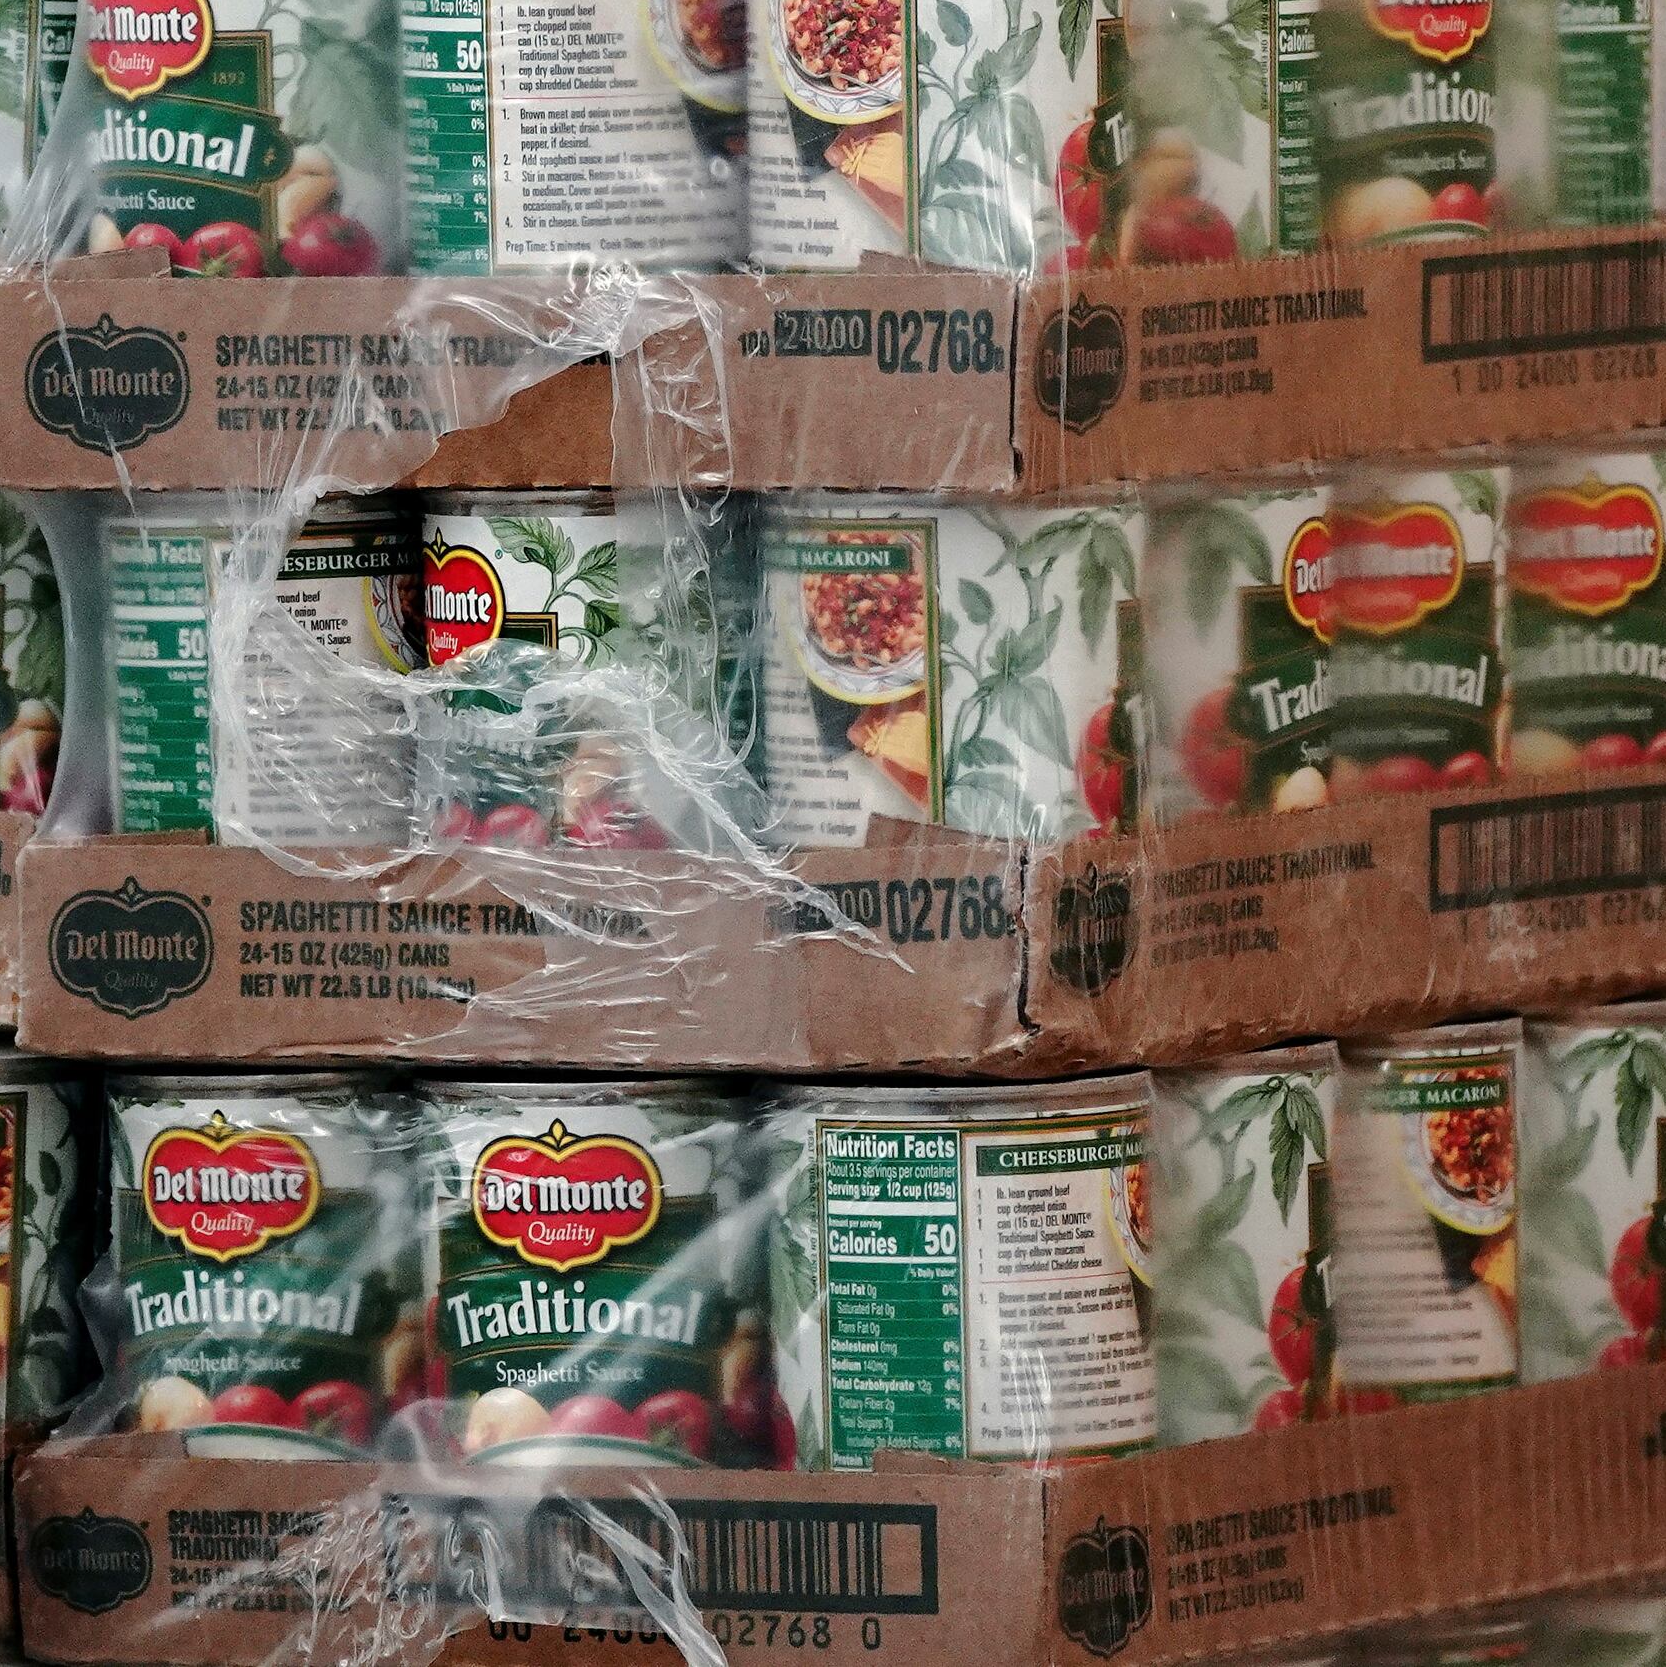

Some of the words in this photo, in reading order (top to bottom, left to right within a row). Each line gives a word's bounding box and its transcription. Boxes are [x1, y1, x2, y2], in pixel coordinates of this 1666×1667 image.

[112, 5, 199, 44] Monte
[528, 5, 546, 17] lean
[547, 5, 576, 21] ground
[576, 4, 596, 17] beef
[1419, 11, 1469, 38] Quality
[533, 20, 567, 34] chopped
[107, 49, 155, 74] Quality
[456, 39, 482, 72] 50
[518, 50, 560, 62] Traditional
[561, 48, 601, 63] Spaghetti
[534, 64, 548, 78] dry
[549, 64, 575, 76] elbow
[534, 79, 572, 91] shredded
[146, 188, 197, 212] Sauce
[782, 313, 865, 354] 24000
[214, 335, 351, 369] SPAGHETTI
[89, 365, 176, 399] Monte
[800, 549, 891, 568] MACARONI
[301, 590, 321, 605] beef
[327, 633, 352, 646] Sauce
[239, 901, 380, 934] SPAGHETTI
[386, 901, 472, 934] SAUCE
[66, 930, 108, 964] Del
[113, 931, 200, 964] Monte
[239, 942, 294, 968] 24-15
[300, 942, 325, 967] OZ
[330, 941, 392, 971] (425g)
[396, 942, 450, 969] CANS
[239, 974, 277, 999] NET
[281, 973, 313, 998] WT
[366, 973, 393, 998] LB
[825, 1133, 899, 1159] Nutrition
[903, 1133, 957, 1160] Facts
[998, 1142, 1123, 1168] CHEESEBURGER
[153, 1164, 195, 1204] Del
[199, 1165, 304, 1205] Monte
[826, 1163, 848, 1179] About
[848, 1162, 862, 1179] 3.5
[862, 1163, 897, 1182] servings
[898, 1166, 913, 1181] per
[914, 1165, 957, 1179] container
[484, 1174, 532, 1214] Del
[536, 1175, 647, 1213] Monte
[827, 1180, 860, 1200] Serving
[860, 1182, 881, 1197] size
[886, 1181, 902, 1198] 1/2
[902, 1183, 922, 1200] cup
[923, 1181, 957, 1200] (125g)
[1026, 1186, 1054, 1203] ground
[1053, 1184, 1071, 1198] beef
[189, 1211, 255, 1237] Quality
[526, 1219, 598, 1248] Quality
[828, 1228, 899, 1256] Calories
[923, 1223, 958, 1256] 50
[830, 1282, 851, 1297] Total
[850, 1283, 866, 1296] Fat
[124, 1269, 365, 1337] Traditional
[446, 1280, 704, 1350] Traditional
[831, 1338, 879, 1354] Cholesterol
[494, 1360, 580, 1387] Spaghetti
[831, 1376, 853, 1391] Total
[852, 1377, 916, 1394] Carbohydrate
[712, 1613, 832, 1651] 02768
[861, 1617, 884, 1652] 0
